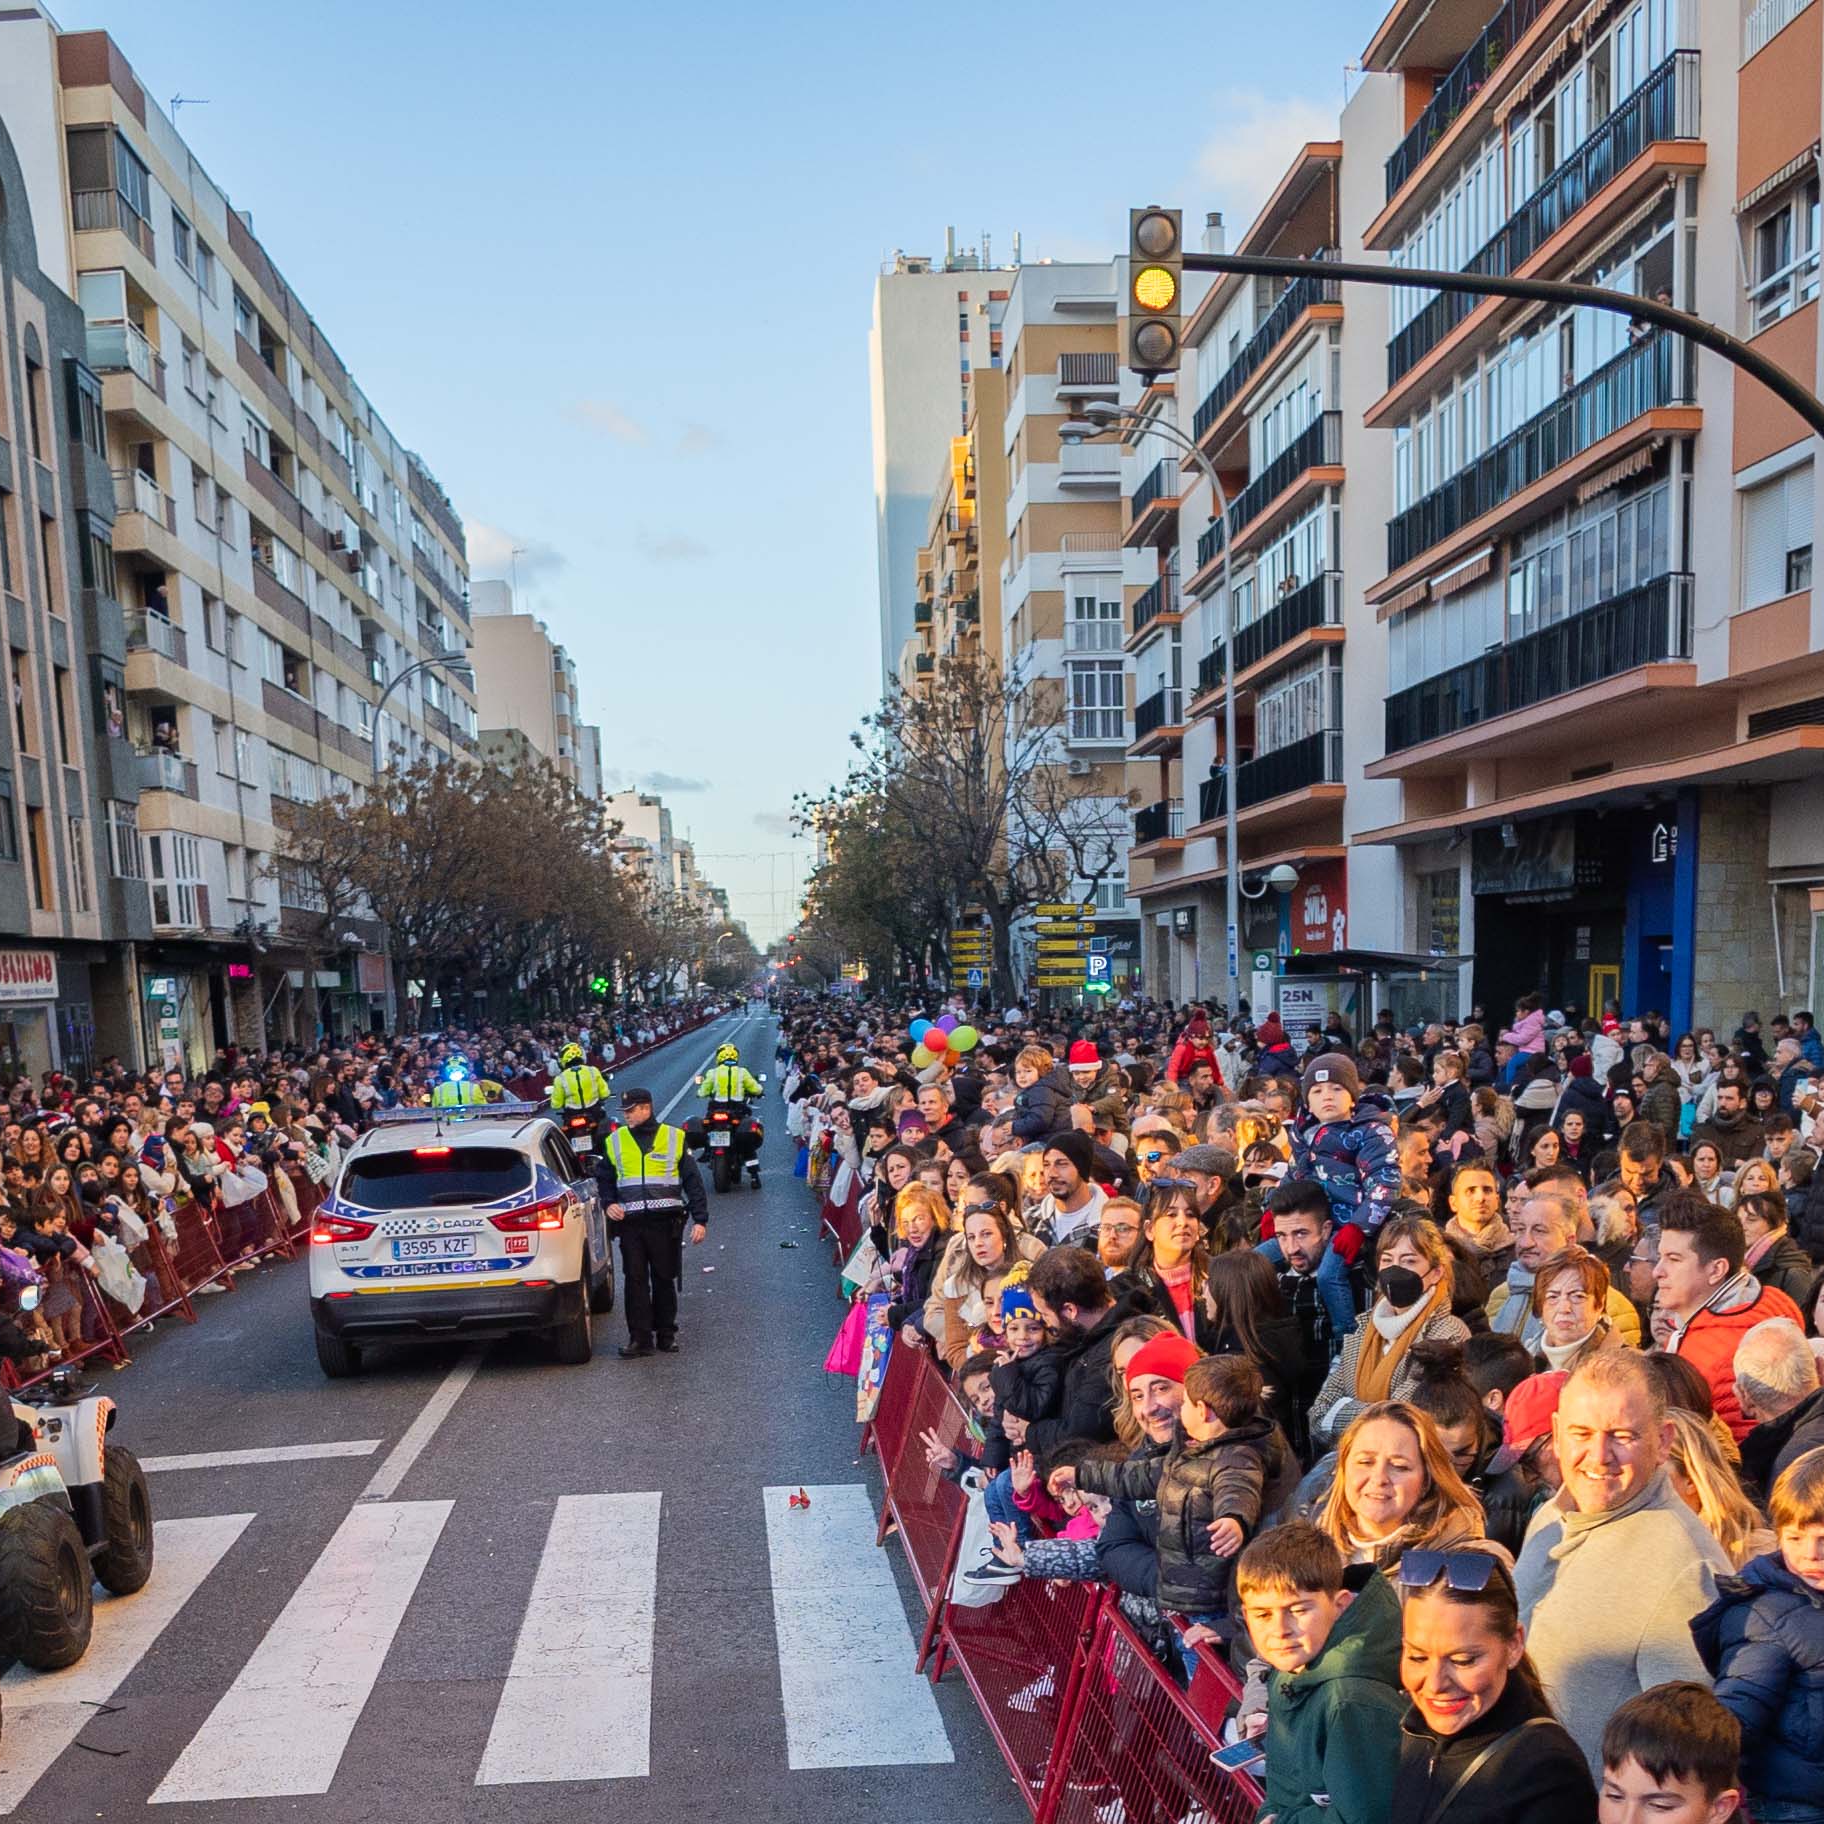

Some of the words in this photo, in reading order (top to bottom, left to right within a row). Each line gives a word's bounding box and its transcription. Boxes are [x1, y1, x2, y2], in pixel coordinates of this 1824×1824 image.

[1282, 990, 1313, 1002] 25N
[443, 1218, 484, 1229] CADIZ
[402, 1240, 437, 1256] 3595
[443, 1237, 470, 1253] KZF
[382, 1264, 439, 1277] POLICIA
[442, 1261, 490, 1273] LOCAL
